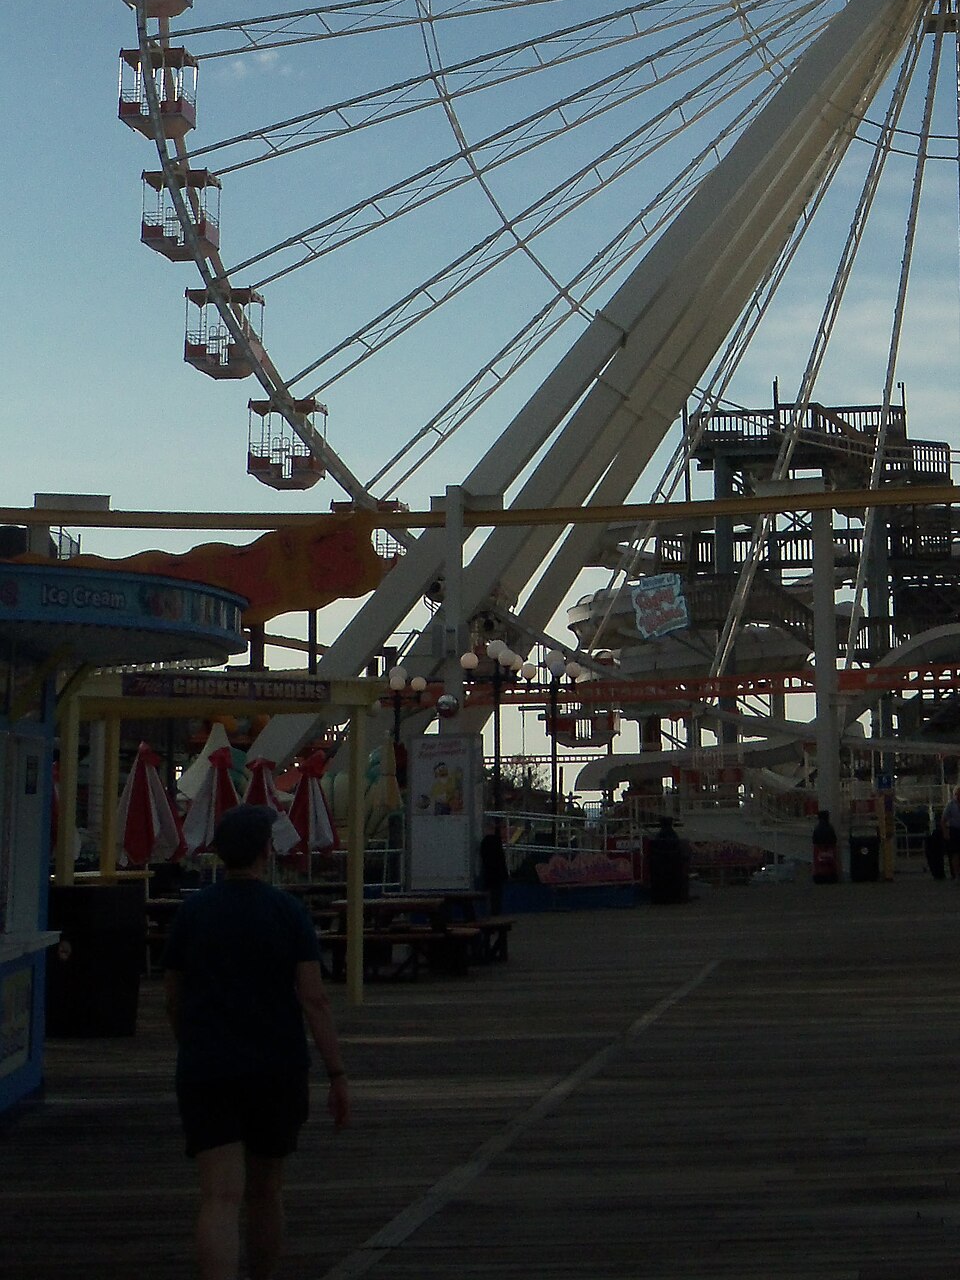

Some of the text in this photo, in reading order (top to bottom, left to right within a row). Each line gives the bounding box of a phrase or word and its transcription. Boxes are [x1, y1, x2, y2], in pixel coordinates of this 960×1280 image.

[41, 584, 125, 608] Ice Cream
[173, 677, 249, 697] CHICKEN
[254, 681, 329, 700] TENDERS
